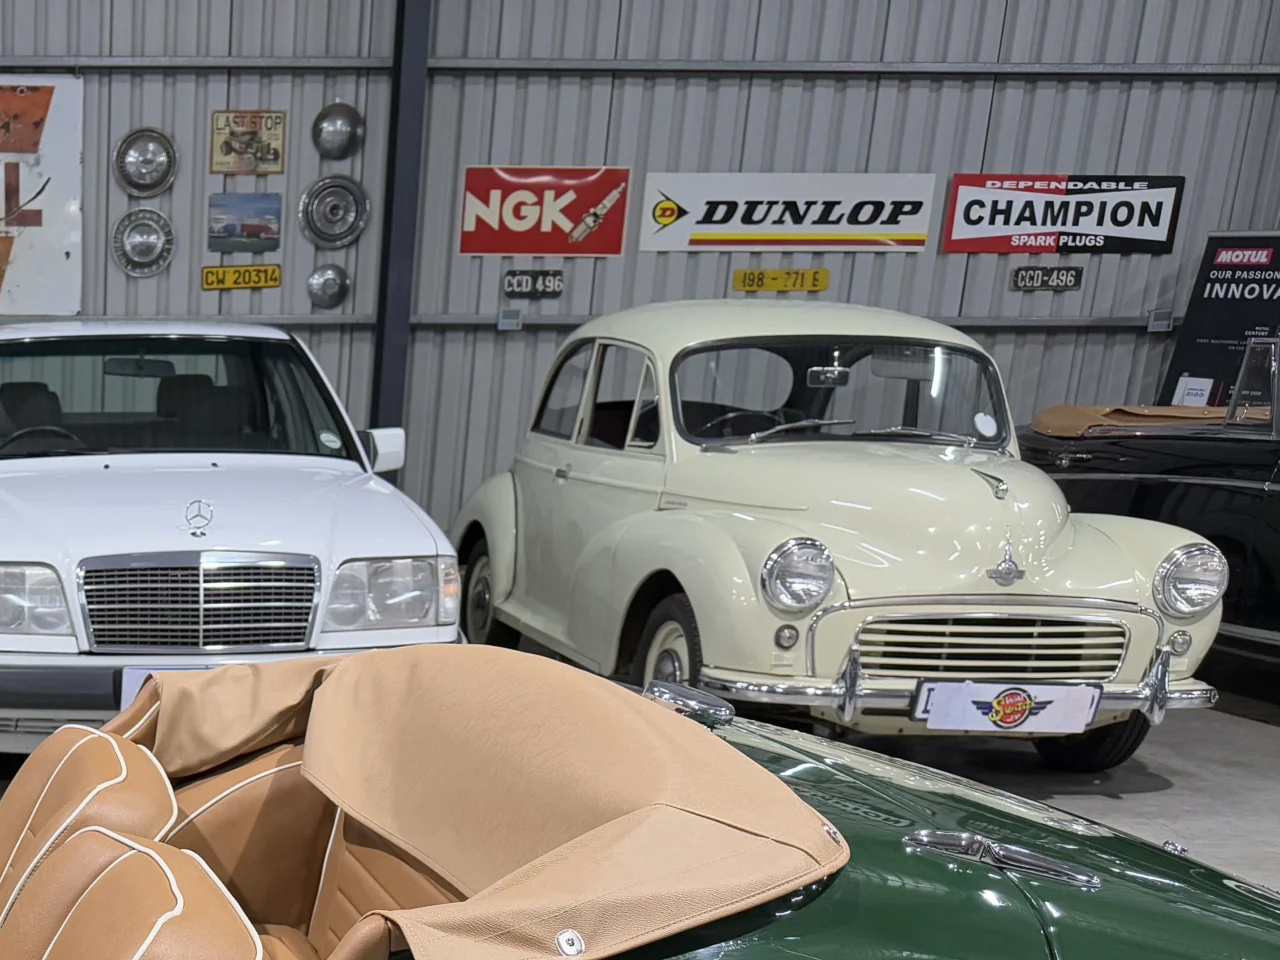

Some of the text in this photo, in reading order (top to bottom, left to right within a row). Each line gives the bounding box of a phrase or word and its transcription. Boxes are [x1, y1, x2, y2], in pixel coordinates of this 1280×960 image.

[215, 115, 282, 131] LAST STOP
[985, 180, 1149, 190] DEPENDABLE
[463, 188, 578, 233] NGK
[694, 200, 924, 226] DUNLOP
[962, 199, 1164, 227] CHAMPION
[1010, 235, 1105, 247] SPARK PLUGS
[1216, 250, 1269, 263] MOTUL
[204, 267, 278, 287] CW 20314
[504, 274, 564, 293] CCD 496
[742, 272, 765, 287] 198
[1017, 269, 1076, 288] CCD-496
[1209, 270, 1280, 280] OUR PASSION
